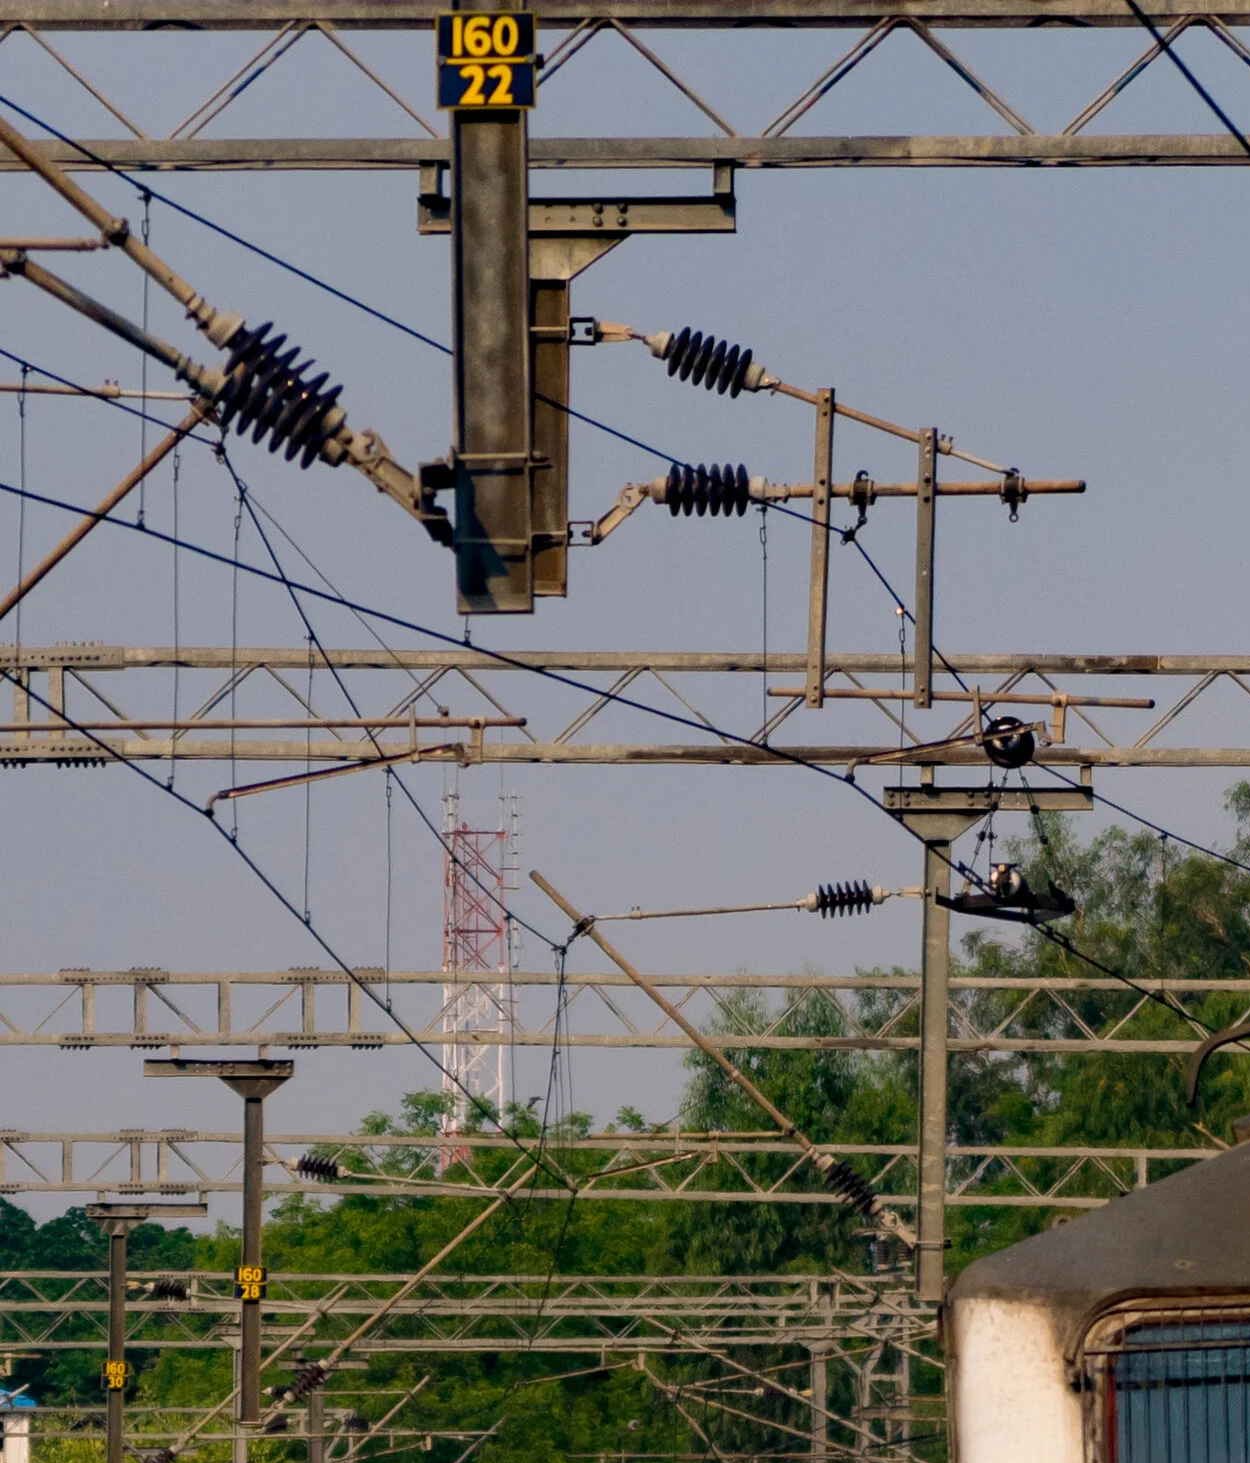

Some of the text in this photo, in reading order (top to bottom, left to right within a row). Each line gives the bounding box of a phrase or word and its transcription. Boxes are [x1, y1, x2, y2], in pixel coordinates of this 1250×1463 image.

[452, 15, 519, 57] 160
[459, 64, 514, 105] 22
[238, 1267, 262, 1282] 160
[241, 1284, 260, 1299] 28
[106, 1361, 125, 1376] 160
[108, 1376, 124, 1388] 30
